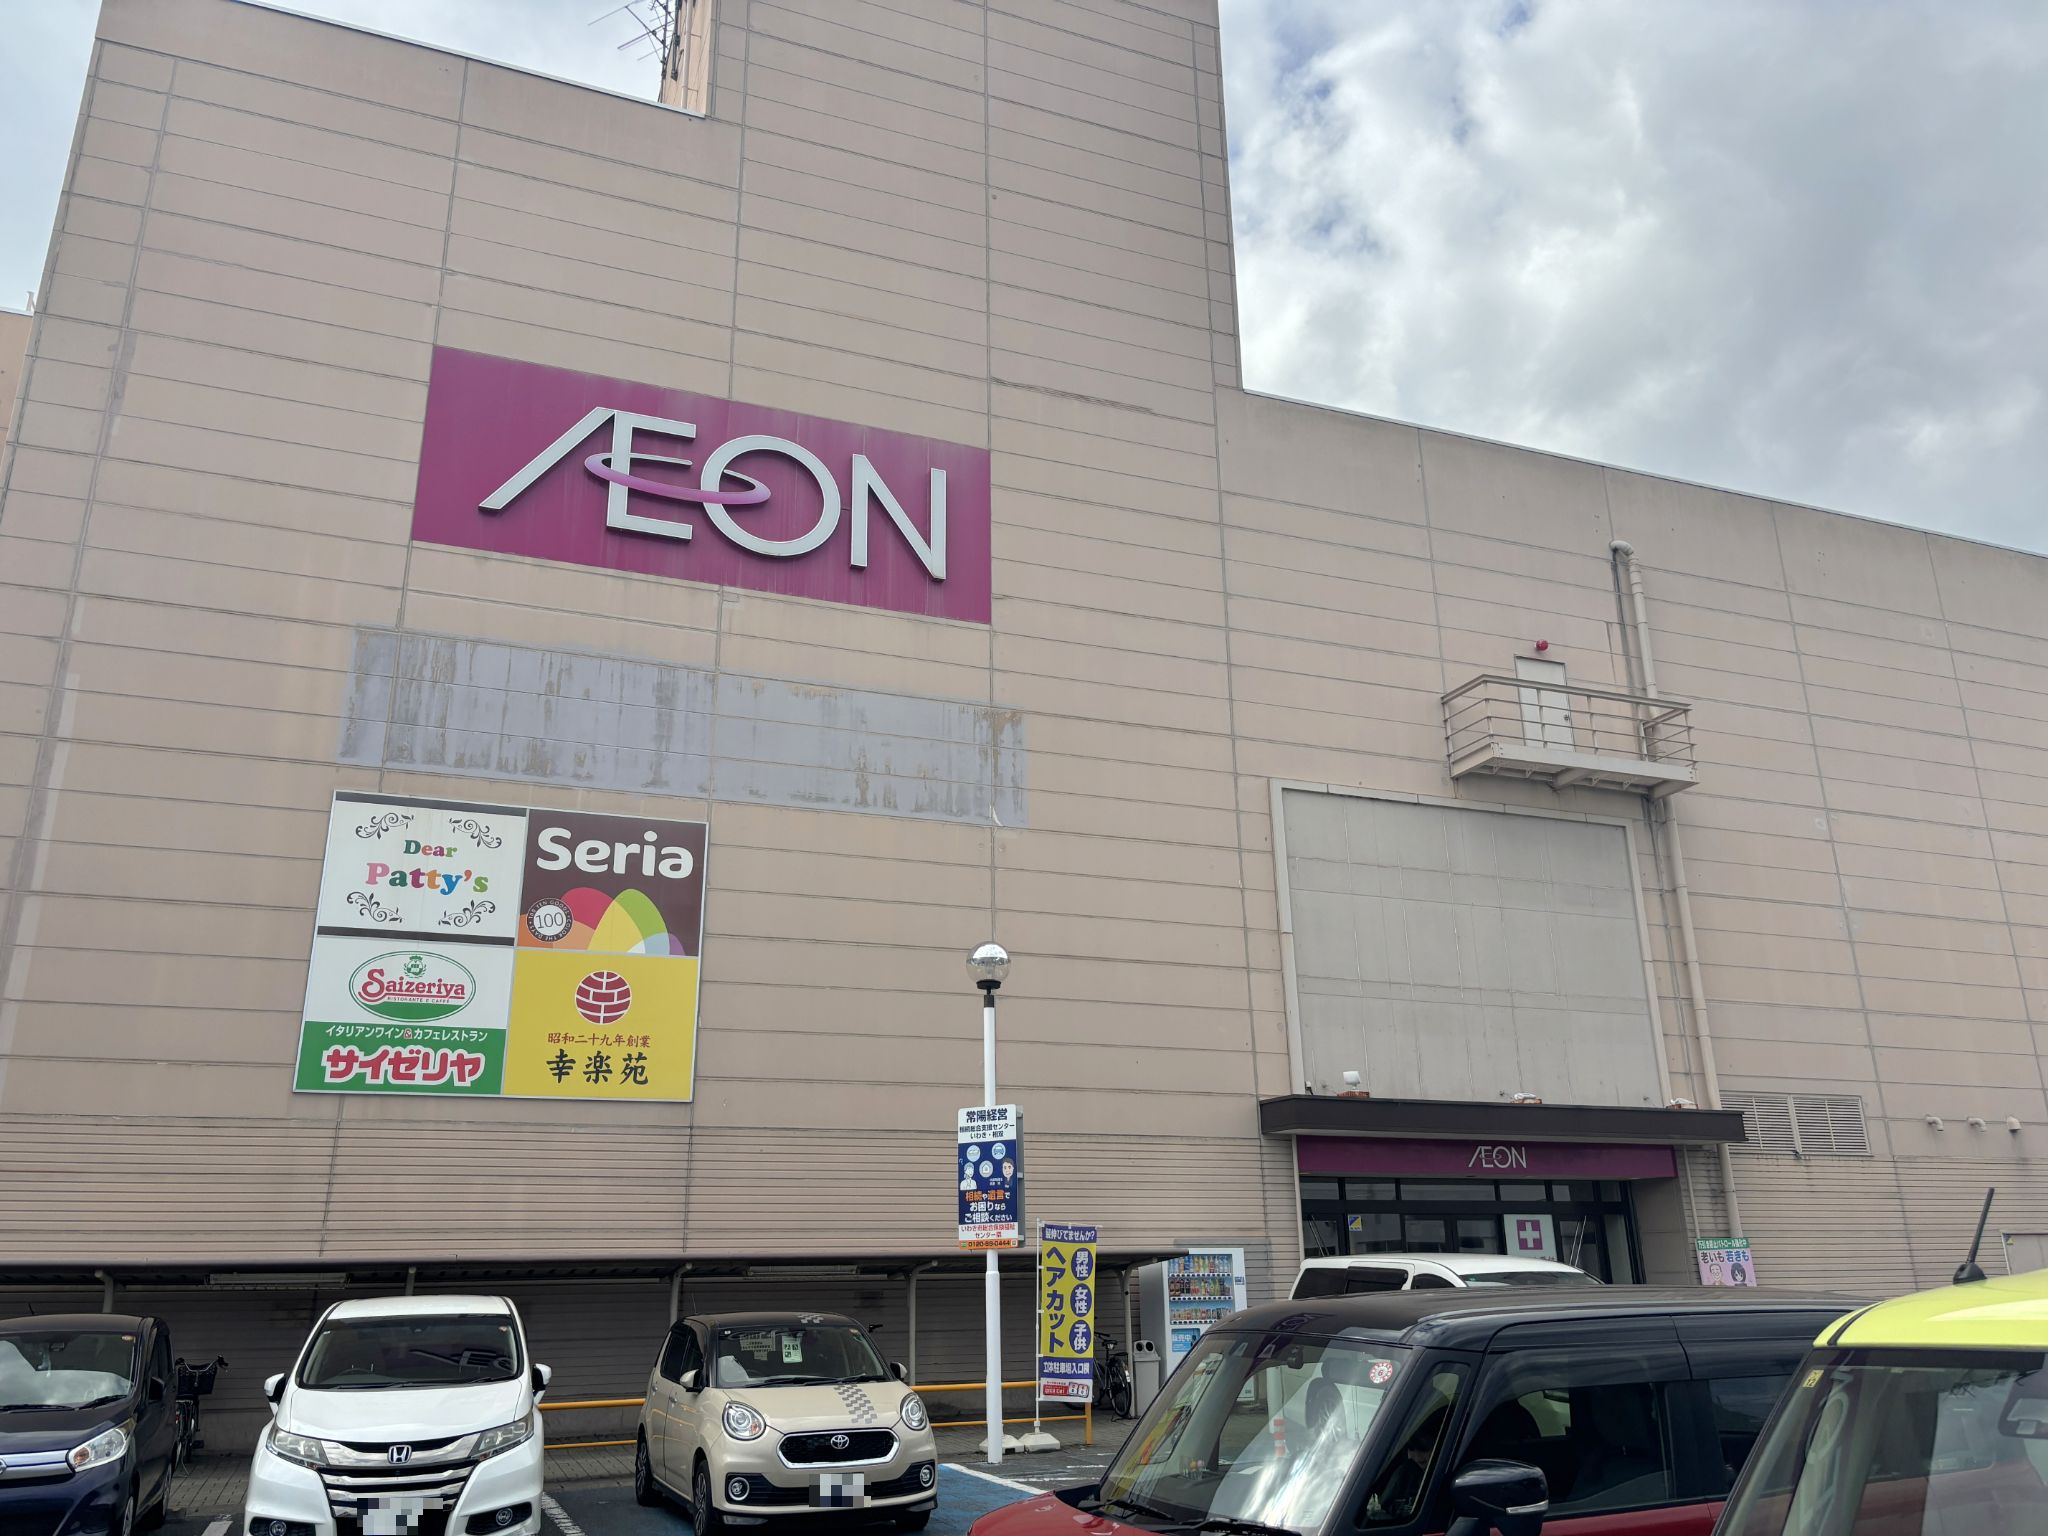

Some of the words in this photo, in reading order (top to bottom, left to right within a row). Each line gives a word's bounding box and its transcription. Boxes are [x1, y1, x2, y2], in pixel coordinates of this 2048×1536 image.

[404, 839, 458, 858] Dear
[536, 826, 694, 879] Seria
[536, 912, 564, 928] 100
[360, 968, 466, 999] Saizeriya
[547, 1032, 652, 1048] 昭和二十九年創業
[325, 1046, 484, 1086] サイゼリヤ
[546, 1048, 649, 1086] 幸楽苑
[966, 1107, 1008, 1123] 常陽経営
[964, 1212, 1013, 1223] ご相談ください
[969, 1201, 1006, 1212] お困りなら
[1075, 1250, 1089, 1278] 男性
[1046, 1246, 1067, 1354] ヘアカット
[1074, 1287, 1088, 1315] 女性
[1073, 1323, 1087, 1351] 子供
